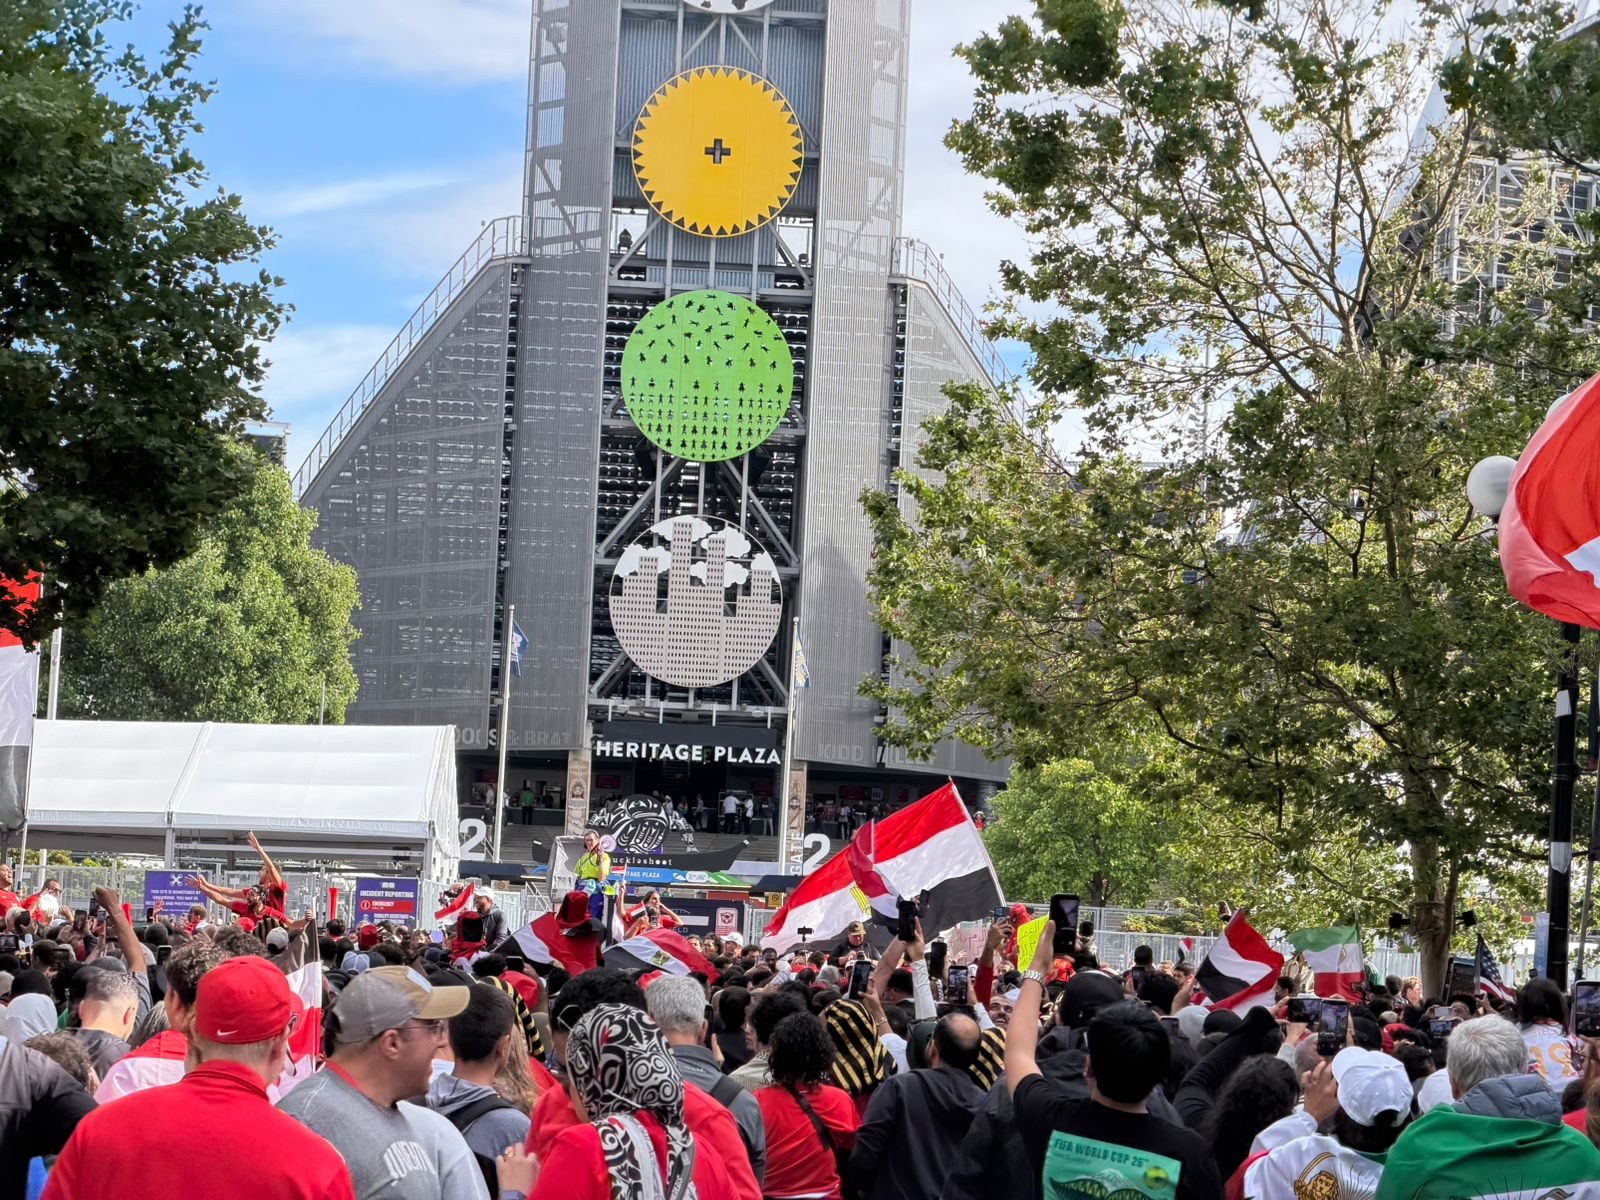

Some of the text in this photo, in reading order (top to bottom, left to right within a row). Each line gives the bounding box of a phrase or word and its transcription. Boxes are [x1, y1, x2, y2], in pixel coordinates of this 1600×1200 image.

[595, 740, 782, 765] HERITAGE PLAZA
[458, 818, 487, 861] 2
[789, 832, 804, 876] GATE
[802, 833, 831, 877] 2
[612, 856, 673, 866] uckleshoot
[1054, 1138, 1073, 1153] FIFA
[1075, 1142, 1110, 1160] WORLD
[1110, 1151, 1131, 1165] CUP
